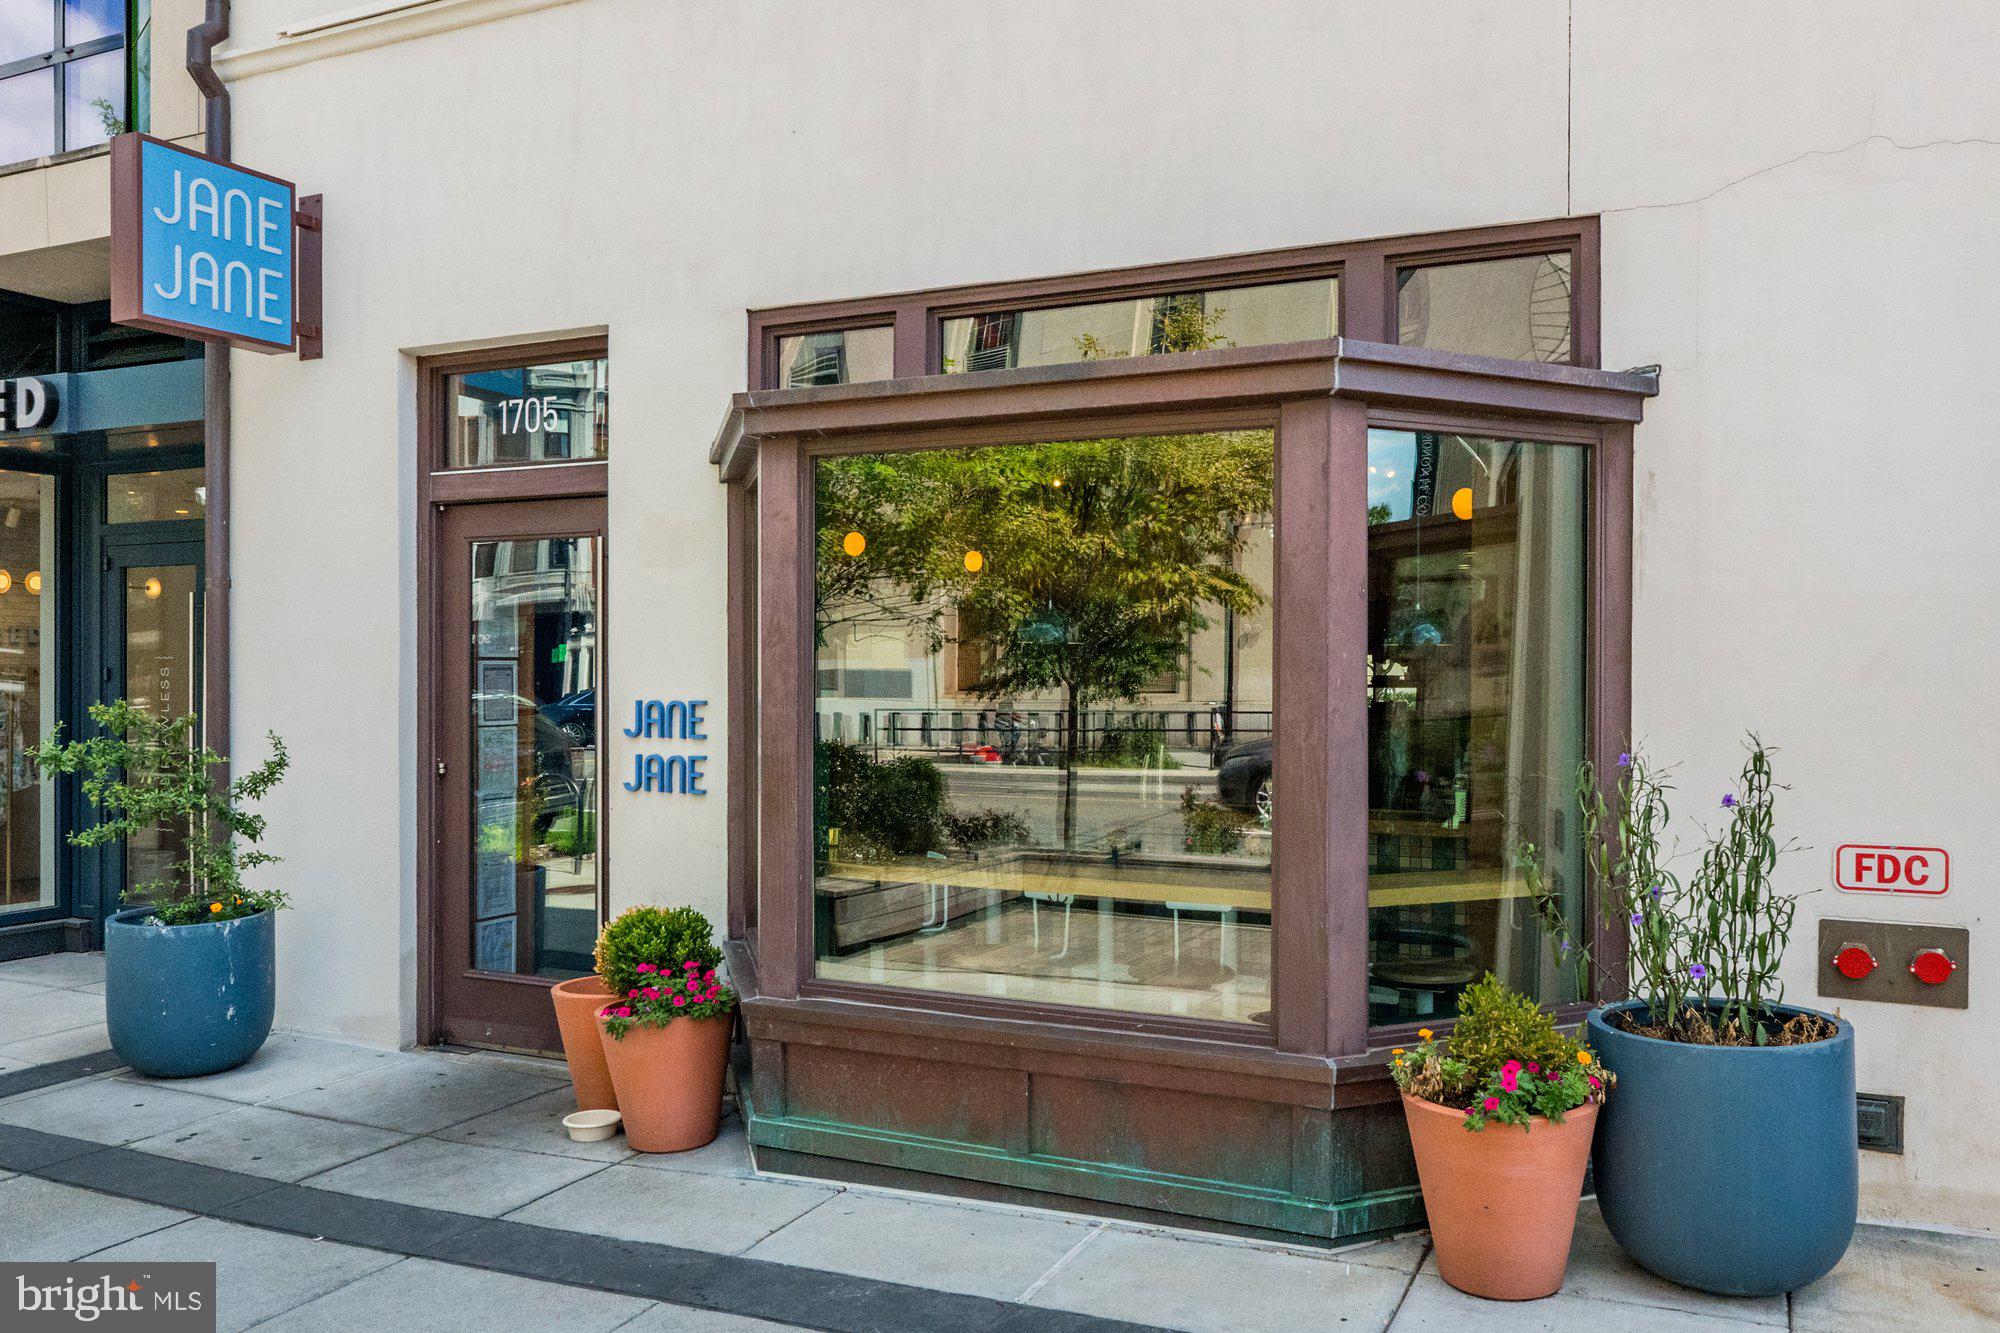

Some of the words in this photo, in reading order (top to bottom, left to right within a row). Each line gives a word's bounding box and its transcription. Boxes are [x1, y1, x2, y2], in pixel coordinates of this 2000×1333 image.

[153, 169, 284, 256] JANE
[153, 244, 285, 326] JANE
[0, 376, 46, 431] D
[498, 395, 558, 435] 1705
[623, 699, 708, 740] JANE
[623, 753, 708, 795] JANE
[1854, 852, 1930, 887] FDC
